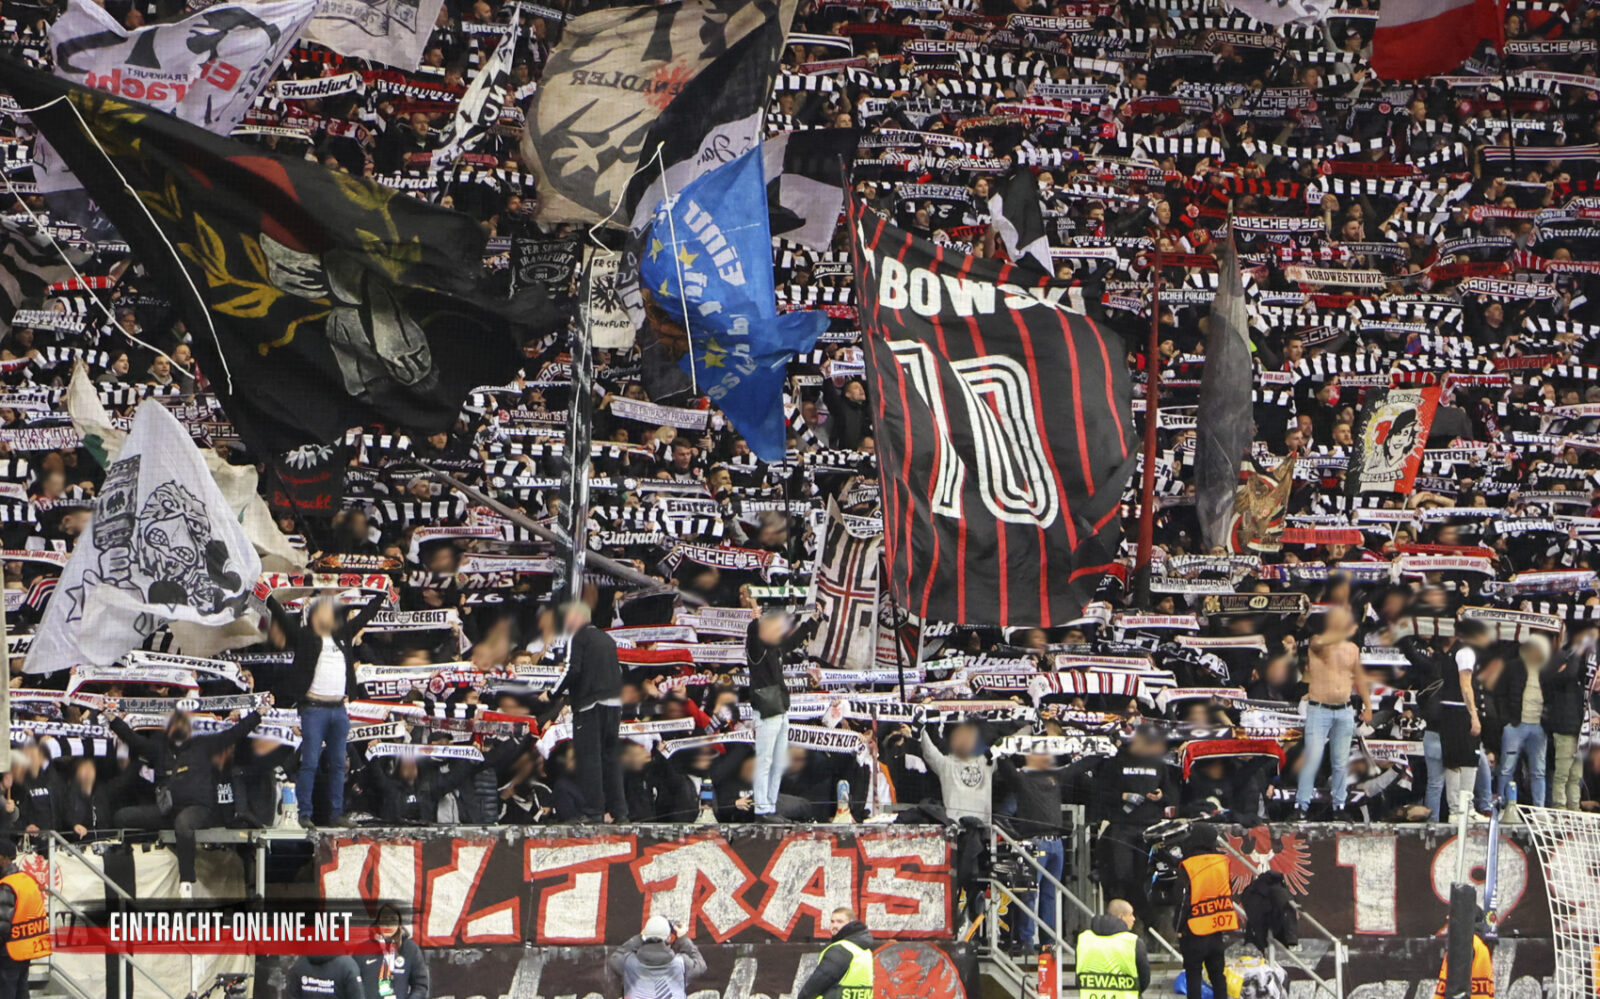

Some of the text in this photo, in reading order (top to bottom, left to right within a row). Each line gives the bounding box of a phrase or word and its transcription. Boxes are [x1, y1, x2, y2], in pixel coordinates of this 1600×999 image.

[904, 41, 965, 53] AGISCHE
[281, 74, 354, 97] Frankfurt
[1484, 118, 1546, 131] Einracht
[375, 171, 437, 189] intracht
[1232, 217, 1289, 230] AGISCHE
[1541, 226, 1600, 239] Frankfu
[1550, 263, 1600, 275] RANKFU
[1306, 269, 1383, 285] NORDWESTKURVE
[510, 410, 551, 421] FRANKFURT
[1160, 414, 1197, 427] Eintr
[885, 339, 1059, 529] 10
[1537, 462, 1588, 479] Eintr
[516, 476, 613, 488] WALDSION
[741, 499, 811, 512] Eintracht
[411, 610, 449, 624] GEBIET
[1470, 609, 1556, 626] Eintracht Eintracht
[514, 664, 556, 675] Eintracht
[972, 674, 1034, 688] MAGISCH
[789, 703, 826, 712] INTRACHT
[10, 719, 114, 738] LDSTADION
[356, 724, 398, 739] GEBIET
[651, 719, 692, 731] Frankfurt
[720, 730, 752, 741] Frankf
[788, 727, 862, 748] ORDWESTKUR
[319, 831, 954, 947] ULTRAS
[1191, 899, 1234, 916] STEWA
[11, 915, 49, 938] STEWA
[1211, 915, 1234, 929] 307
[1079, 975, 1135, 989] TEWARD
